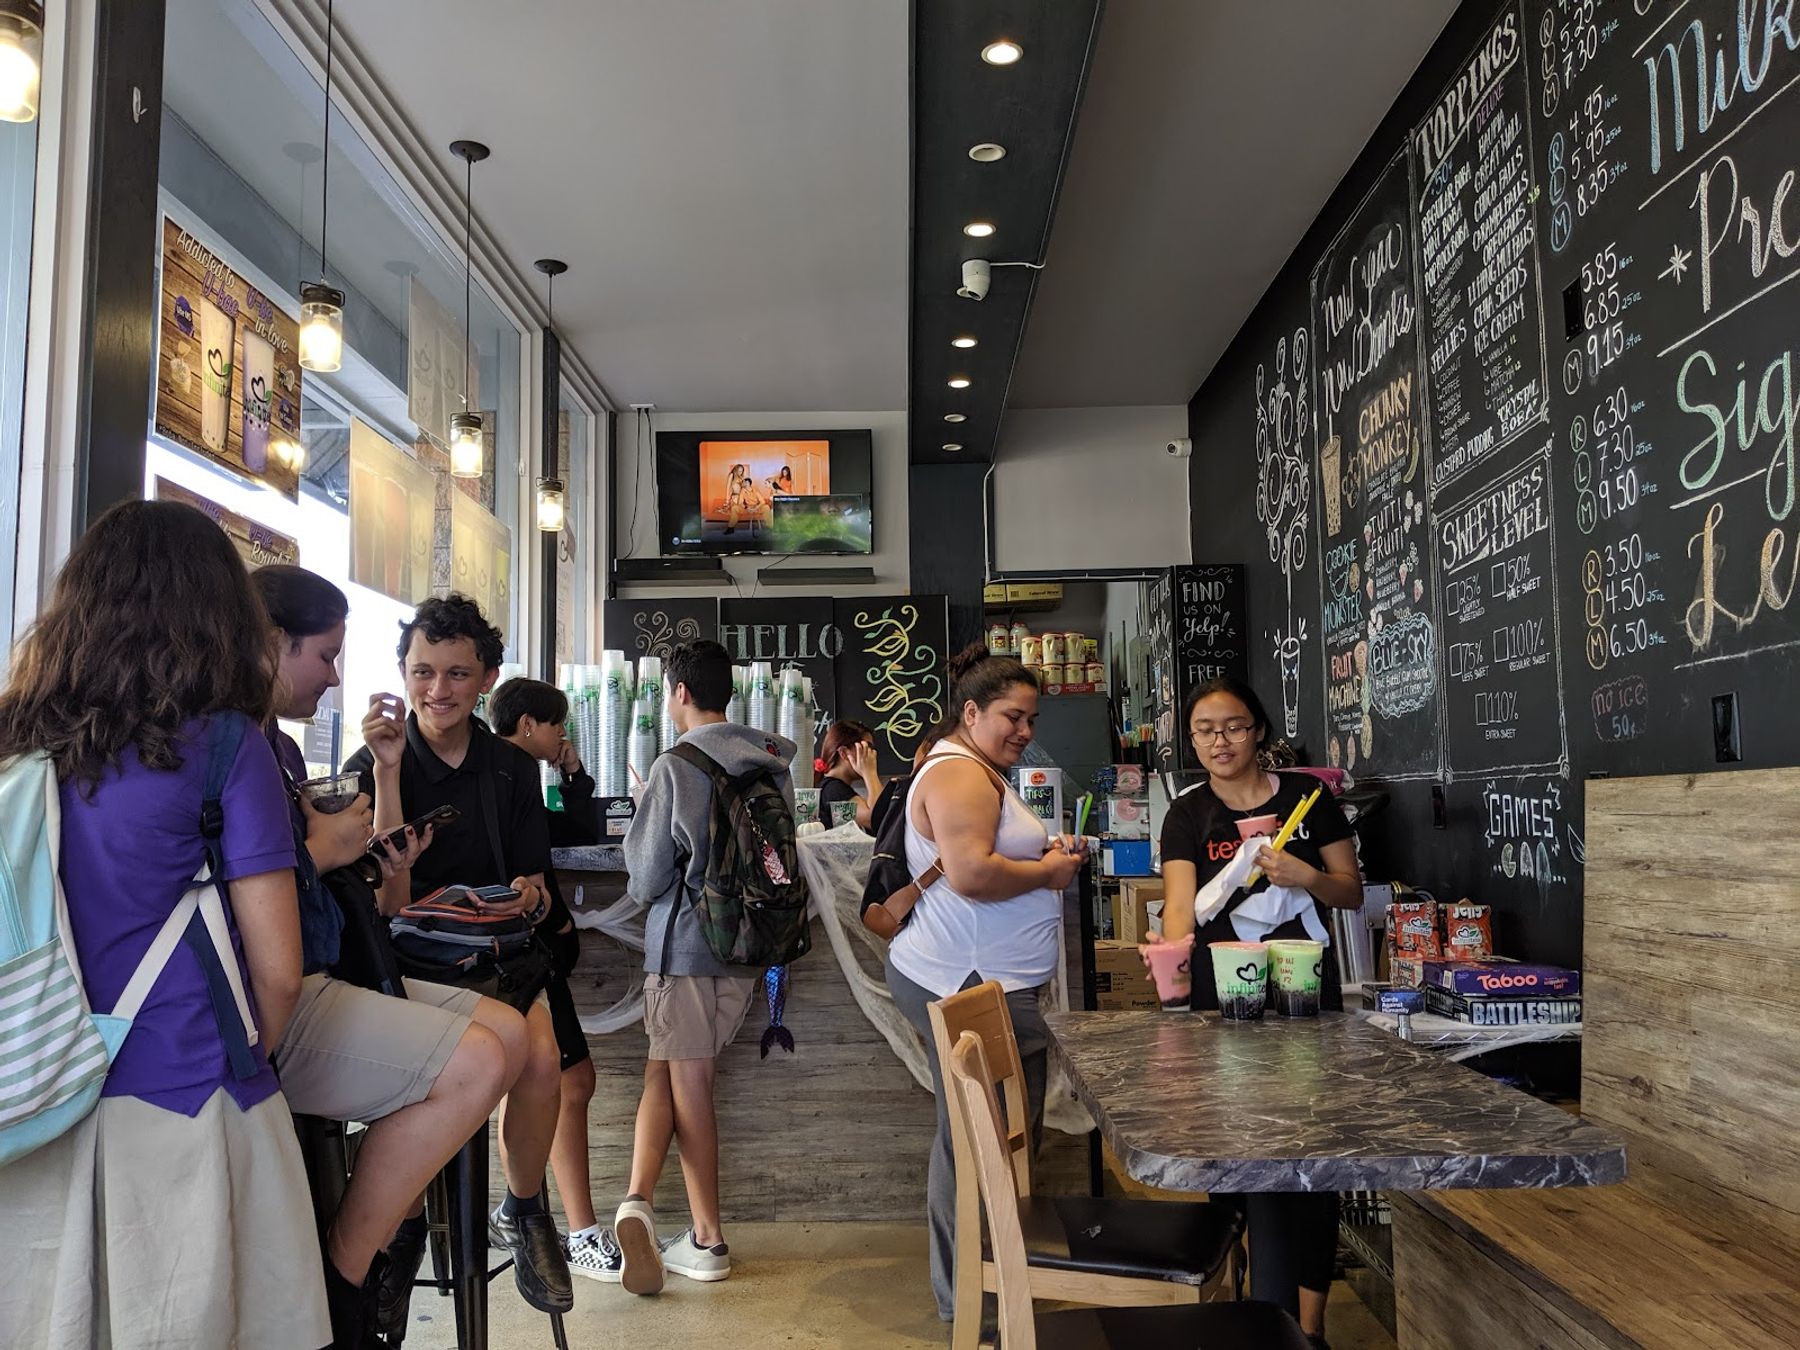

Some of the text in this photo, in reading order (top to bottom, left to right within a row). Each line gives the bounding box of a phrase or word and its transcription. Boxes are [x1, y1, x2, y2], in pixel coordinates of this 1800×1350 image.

[1562, 24, 1598, 90] 7.30
[1415, 12, 1521, 182] TOPPINGS
[1569, 83, 1605, 143] 4.95
[1571, 119, 1605, 181] 5.95
[1577, 160, 1608, 217] 8.35
[176, 229, 236, 288] Addicted to
[1581, 241, 1617, 294] 5.85
[1495, 256, 1527, 309] SEEDS
[1474, 292, 1526, 359] ICE CREAM
[1584, 281, 1619, 330] 6.85
[255, 316, 289, 354] in love
[1431, 318, 1468, 375] JELLIES
[1587, 320, 1624, 376] 9.15
[1358, 371, 1412, 445] CHUNKY
[1593, 386, 1627, 437] 6.30
[1363, 420, 1411, 481] MONKEY
[1597, 424, 1634, 480] 7.30
[1598, 467, 1637, 520] 9.50
[1369, 497, 1403, 539] TUTTI
[1442, 464, 1544, 571] SWEETNESS
[1490, 495, 1549, 557] LEVEL
[1325, 538, 1358, 575] COOKIE
[1604, 533, 1642, 578] 3.50
[1182, 581, 1226, 603] FIND
[1459, 552, 1531, 606] 25% 50%
[1521, 576, 1542, 595] SWEET
[1605, 571, 1646, 615] 4.50
[1182, 611, 1231, 647] Yelp!
[1183, 603, 1221, 616] US ON
[1324, 589, 1364, 634] MONSTER
[720, 623, 843, 660] HELLO
[1461, 617, 1545, 673] 75% 100%
[1532, 651, 1551, 666] SWEET
[1609, 617, 1648, 659] 6.50
[1331, 651, 1353, 682] FRUIT
[1474, 664, 1490, 681] SWEET
[1328, 674, 1363, 713] MACHINE
[1487, 690, 1519, 724] 110%
[1499, 728, 1518, 740] SWEET
[1488, 793, 1554, 838] GAMES
[1452, 906, 1483, 920] Jelly
[1476, 973, 1538, 991] Taboo
[1381, 1001, 1404, 1009] Against
[1471, 1001, 1581, 1025] BATTLESHIP
